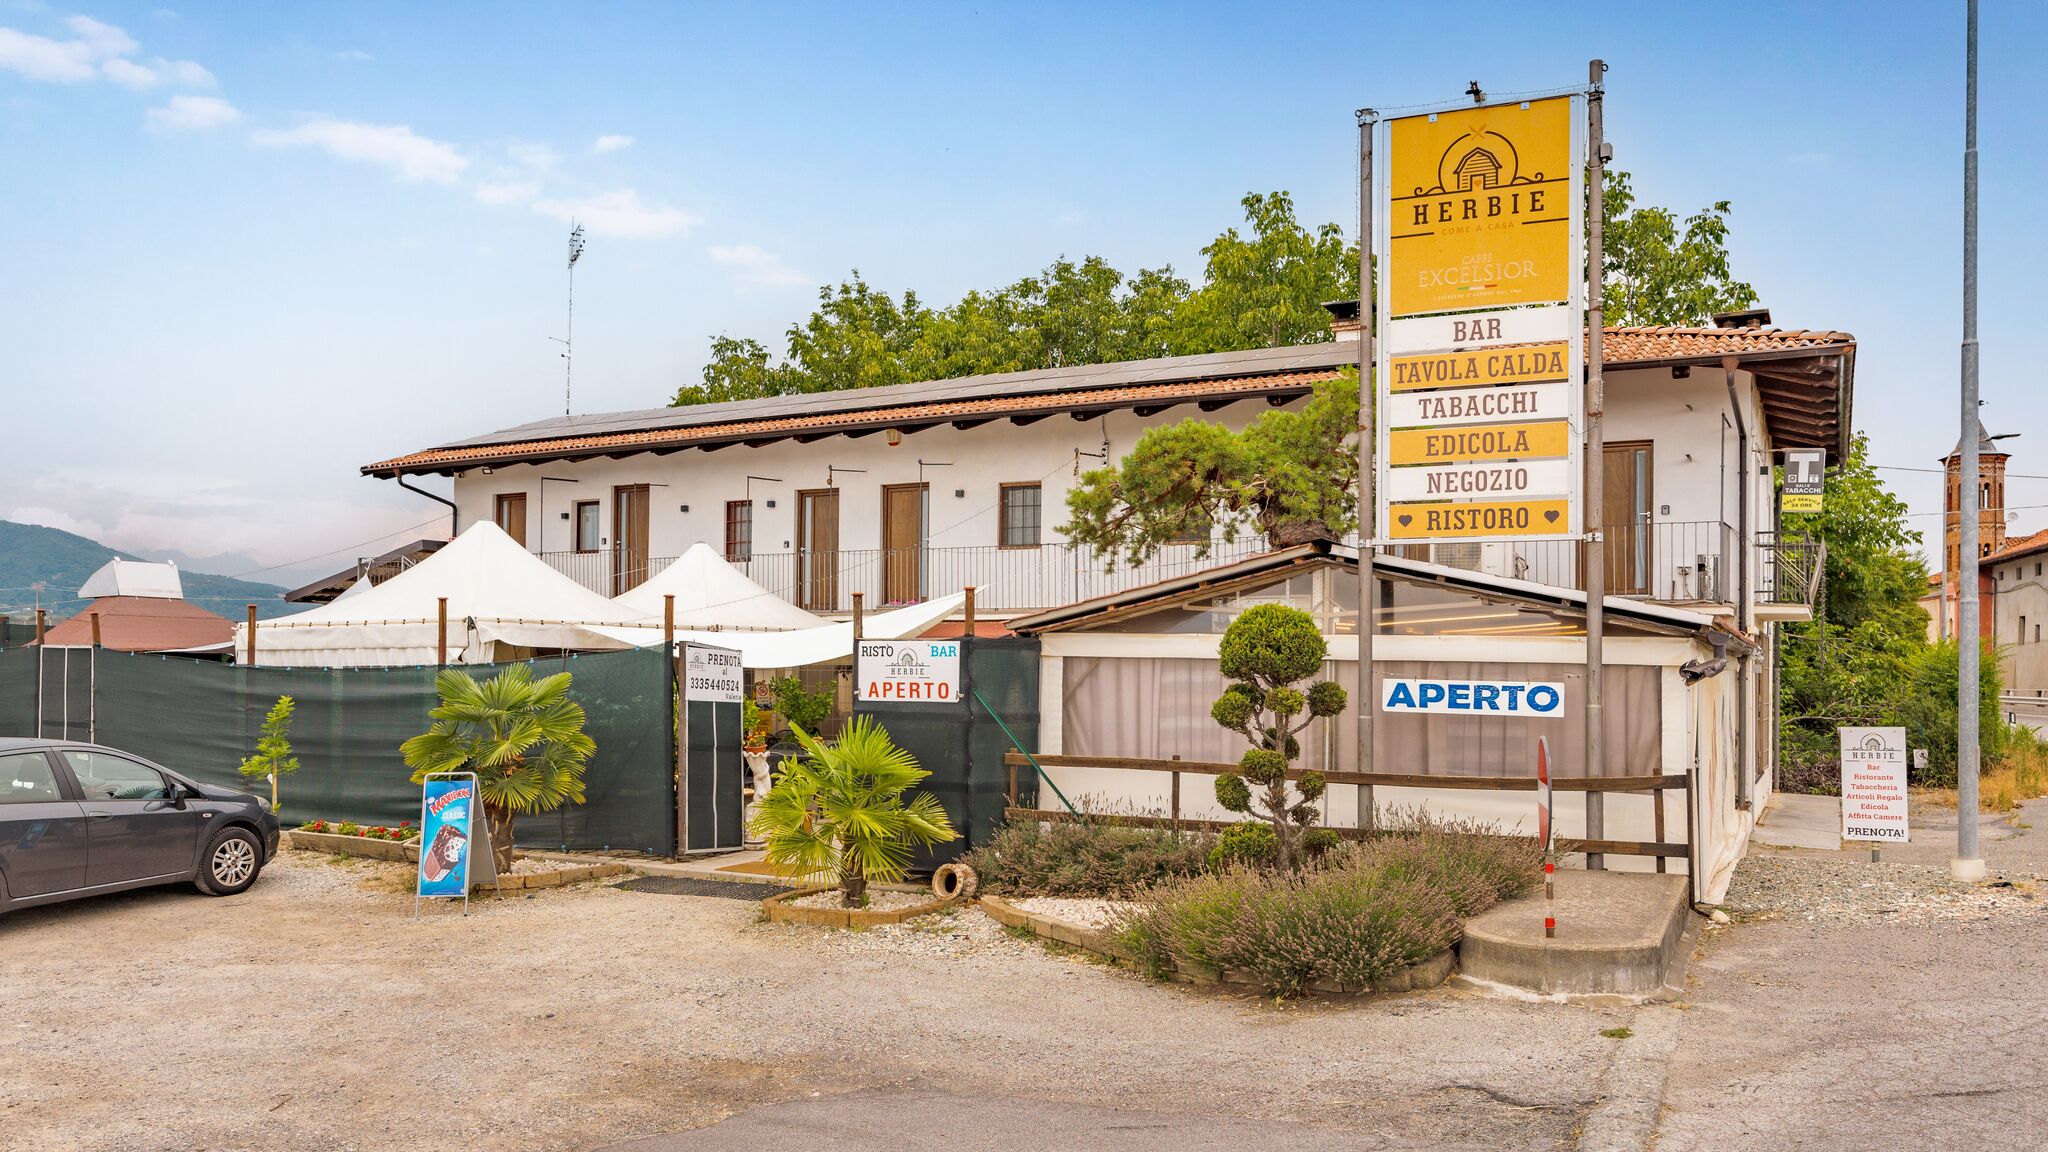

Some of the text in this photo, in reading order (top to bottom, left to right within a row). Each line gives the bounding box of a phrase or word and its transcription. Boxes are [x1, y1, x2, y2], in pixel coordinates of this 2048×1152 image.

[1413, 191, 1545, 225] HERBIE
[1442, 221, 1515, 236] COME A CASA
[1418, 260, 1539, 288] EXCELSIOR
[1453, 318, 1502, 342] BAR
[1395, 351, 1564, 384] TAVOLA CALDA
[1418, 391, 1538, 420] TABACCHI
[1425, 430, 1530, 457] EDICOLA
[1427, 468, 1528, 494] NEGOZIO
[1797, 497, 1821, 506] SERVICE
[1426, 507, 1529, 531] RISTORO
[930, 645, 957, 657] BAR
[707, 653, 742, 668] PRENOTA
[722, 667, 728, 676] al
[690, 677, 739, 692] 3335440524
[868, 681, 950, 699] APERTO
[1386, 682, 1560, 712] APERTO
[1852, 752, 1895, 760] HERBIE
[1854, 773, 1894, 781] Ristorante
[1850, 783, 1898, 791] Tabaccheria
[1846, 793, 1903, 802] Articoli Regalo
[1860, 803, 1889, 811] Edicola
[1847, 812, 1903, 821] Affitta Camere
[1847, 827, 1904, 838] PRENOTA!
